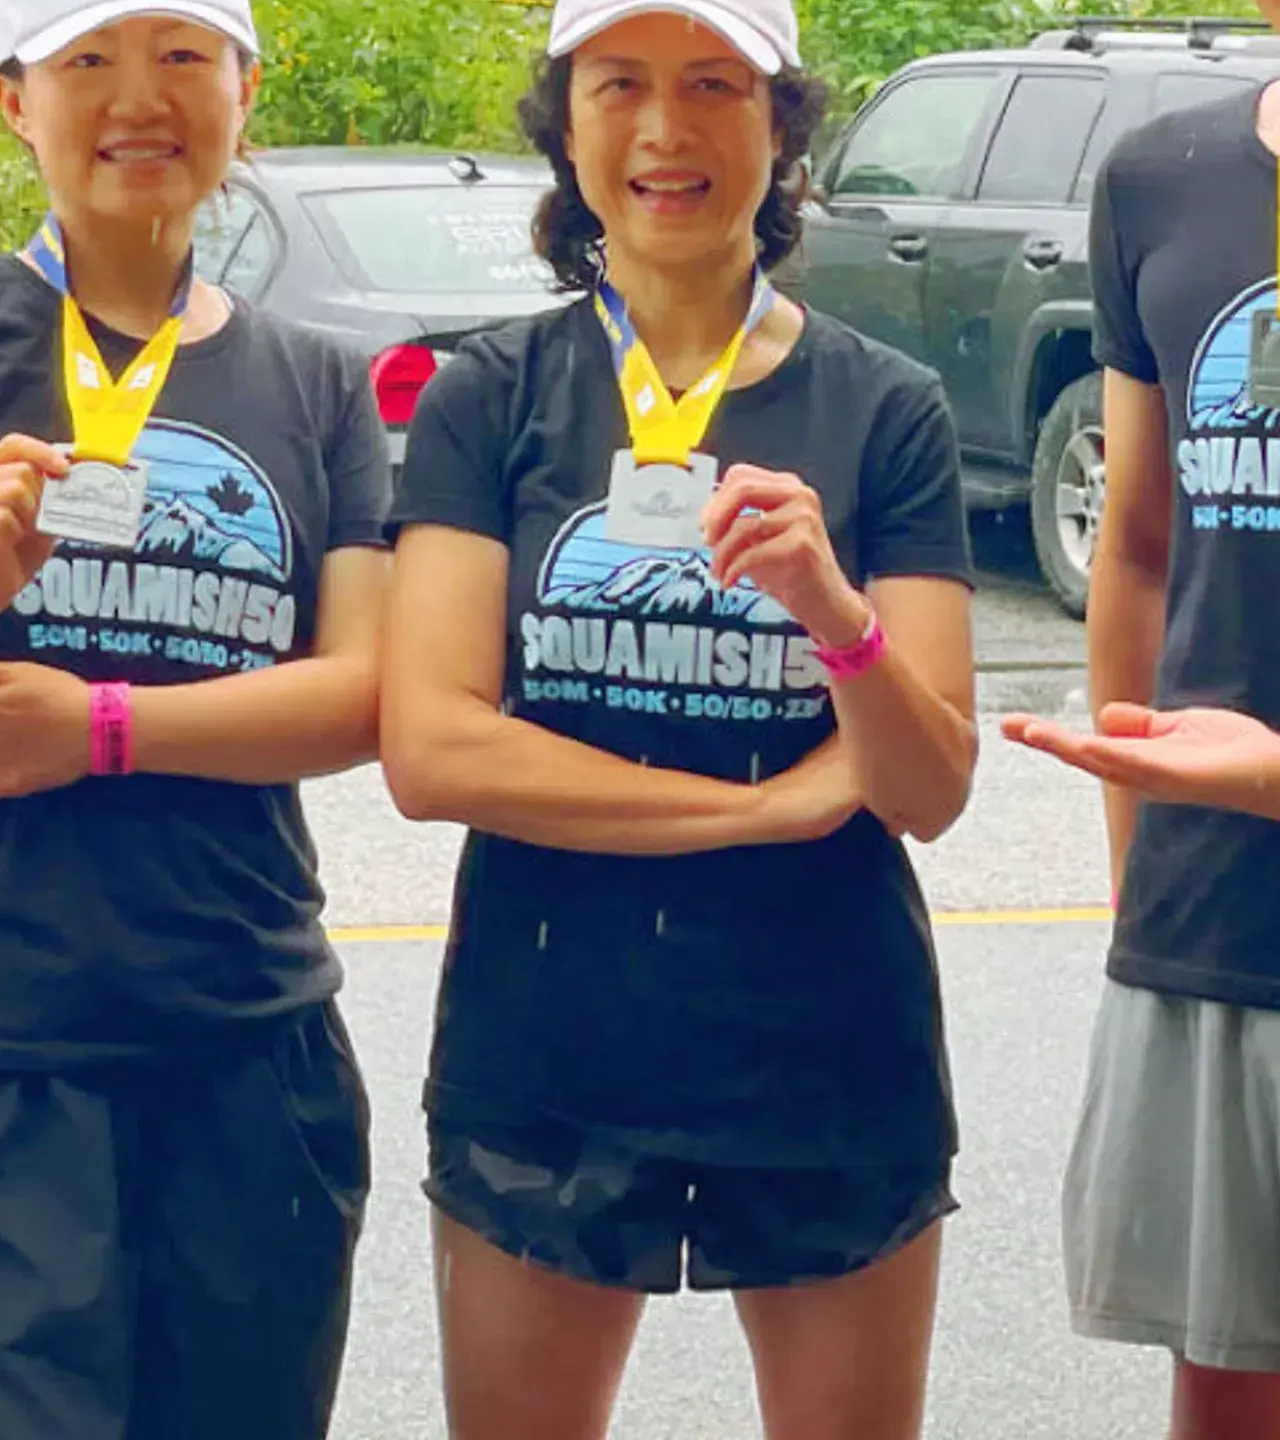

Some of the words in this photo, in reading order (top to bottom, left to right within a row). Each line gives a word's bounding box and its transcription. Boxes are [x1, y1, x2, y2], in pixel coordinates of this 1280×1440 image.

[521, 612, 830, 692] SQUAMISH5
[523, 678, 589, 702] 50M
[605, 685, 668, 714] 50K
